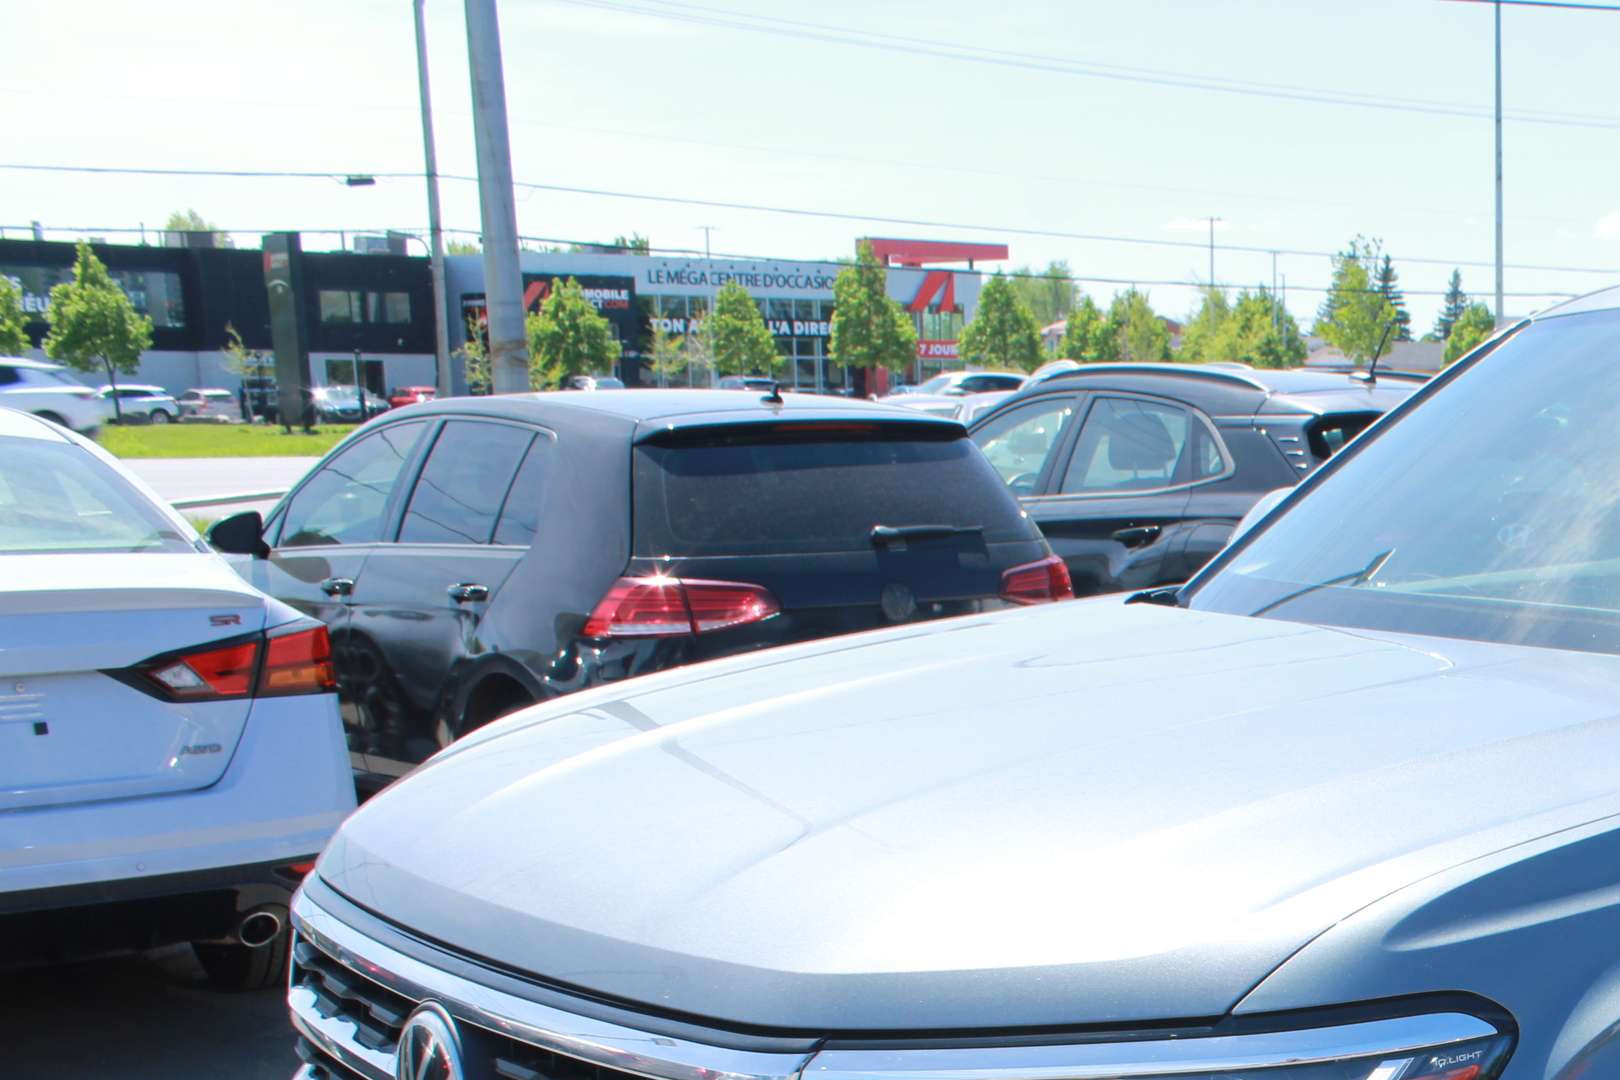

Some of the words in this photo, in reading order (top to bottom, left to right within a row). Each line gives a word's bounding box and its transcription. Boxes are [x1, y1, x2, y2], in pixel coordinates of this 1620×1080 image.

[648, 269, 663, 284] LE
[667, 268, 708, 286] MÉGA
[710, 271, 760, 287] CENTRE
[764, 274, 840, 290] D'OCCASIO
[582, 288, 629, 300] MOBILE
[650, 318, 686, 334] TON
[209, 614, 241, 627] SR
